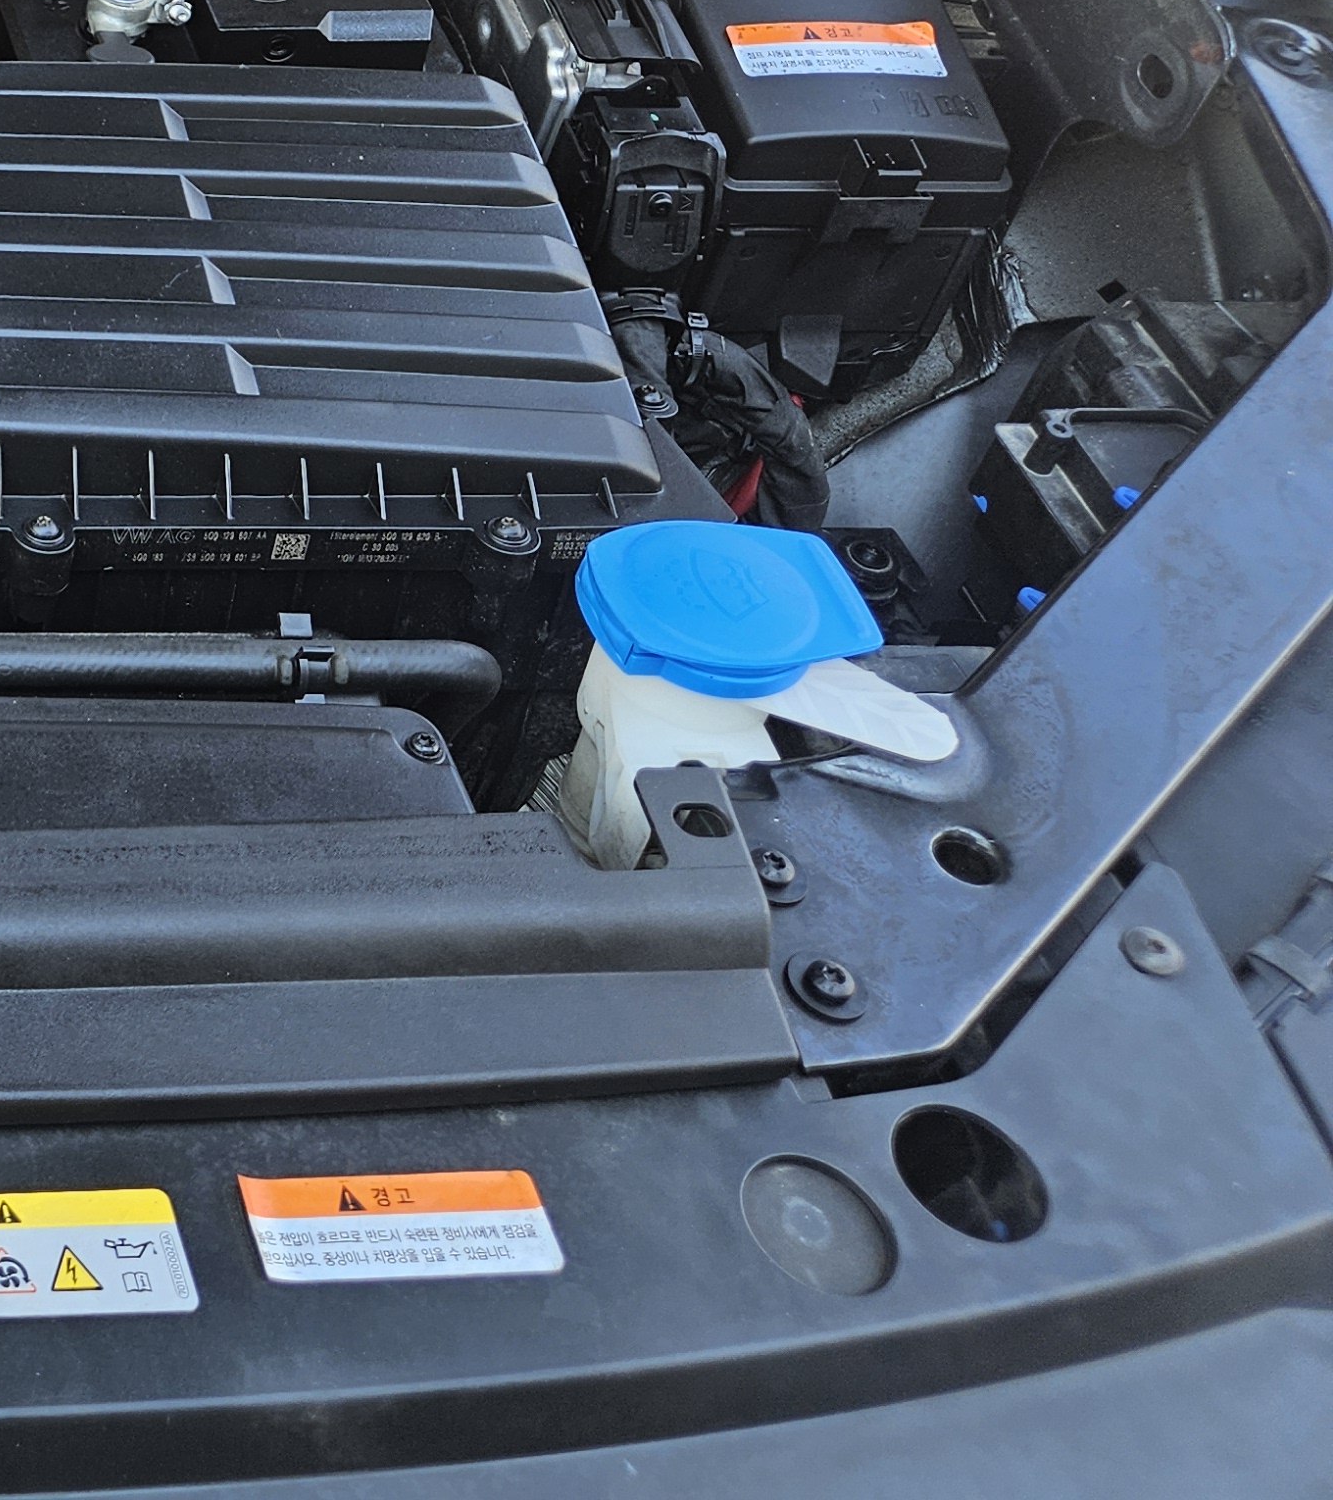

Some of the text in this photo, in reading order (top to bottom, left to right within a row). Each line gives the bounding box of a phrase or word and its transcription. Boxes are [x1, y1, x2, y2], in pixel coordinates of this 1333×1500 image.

[112, 527, 196, 545] VW AG
[371, 1186, 415, 1207] 경고
[278, 1231, 314, 1246] 전압이
[317, 1230, 364, 1244] 흐르므로
[365, 1228, 402, 1243] 반드시
[405, 1226, 440, 1241] 숙련된
[441, 1225, 501, 1241] 정비사에게
[501, 1223, 539, 1239] 점검을
[322, 1250, 370, 1267] 중상이나
[372, 1247, 420, 1264] 치명상을
[421, 1246, 447, 1263] 입을
[449, 1246, 462, 1261] 수
[463, 1244, 515, 1261] 있습니다.
